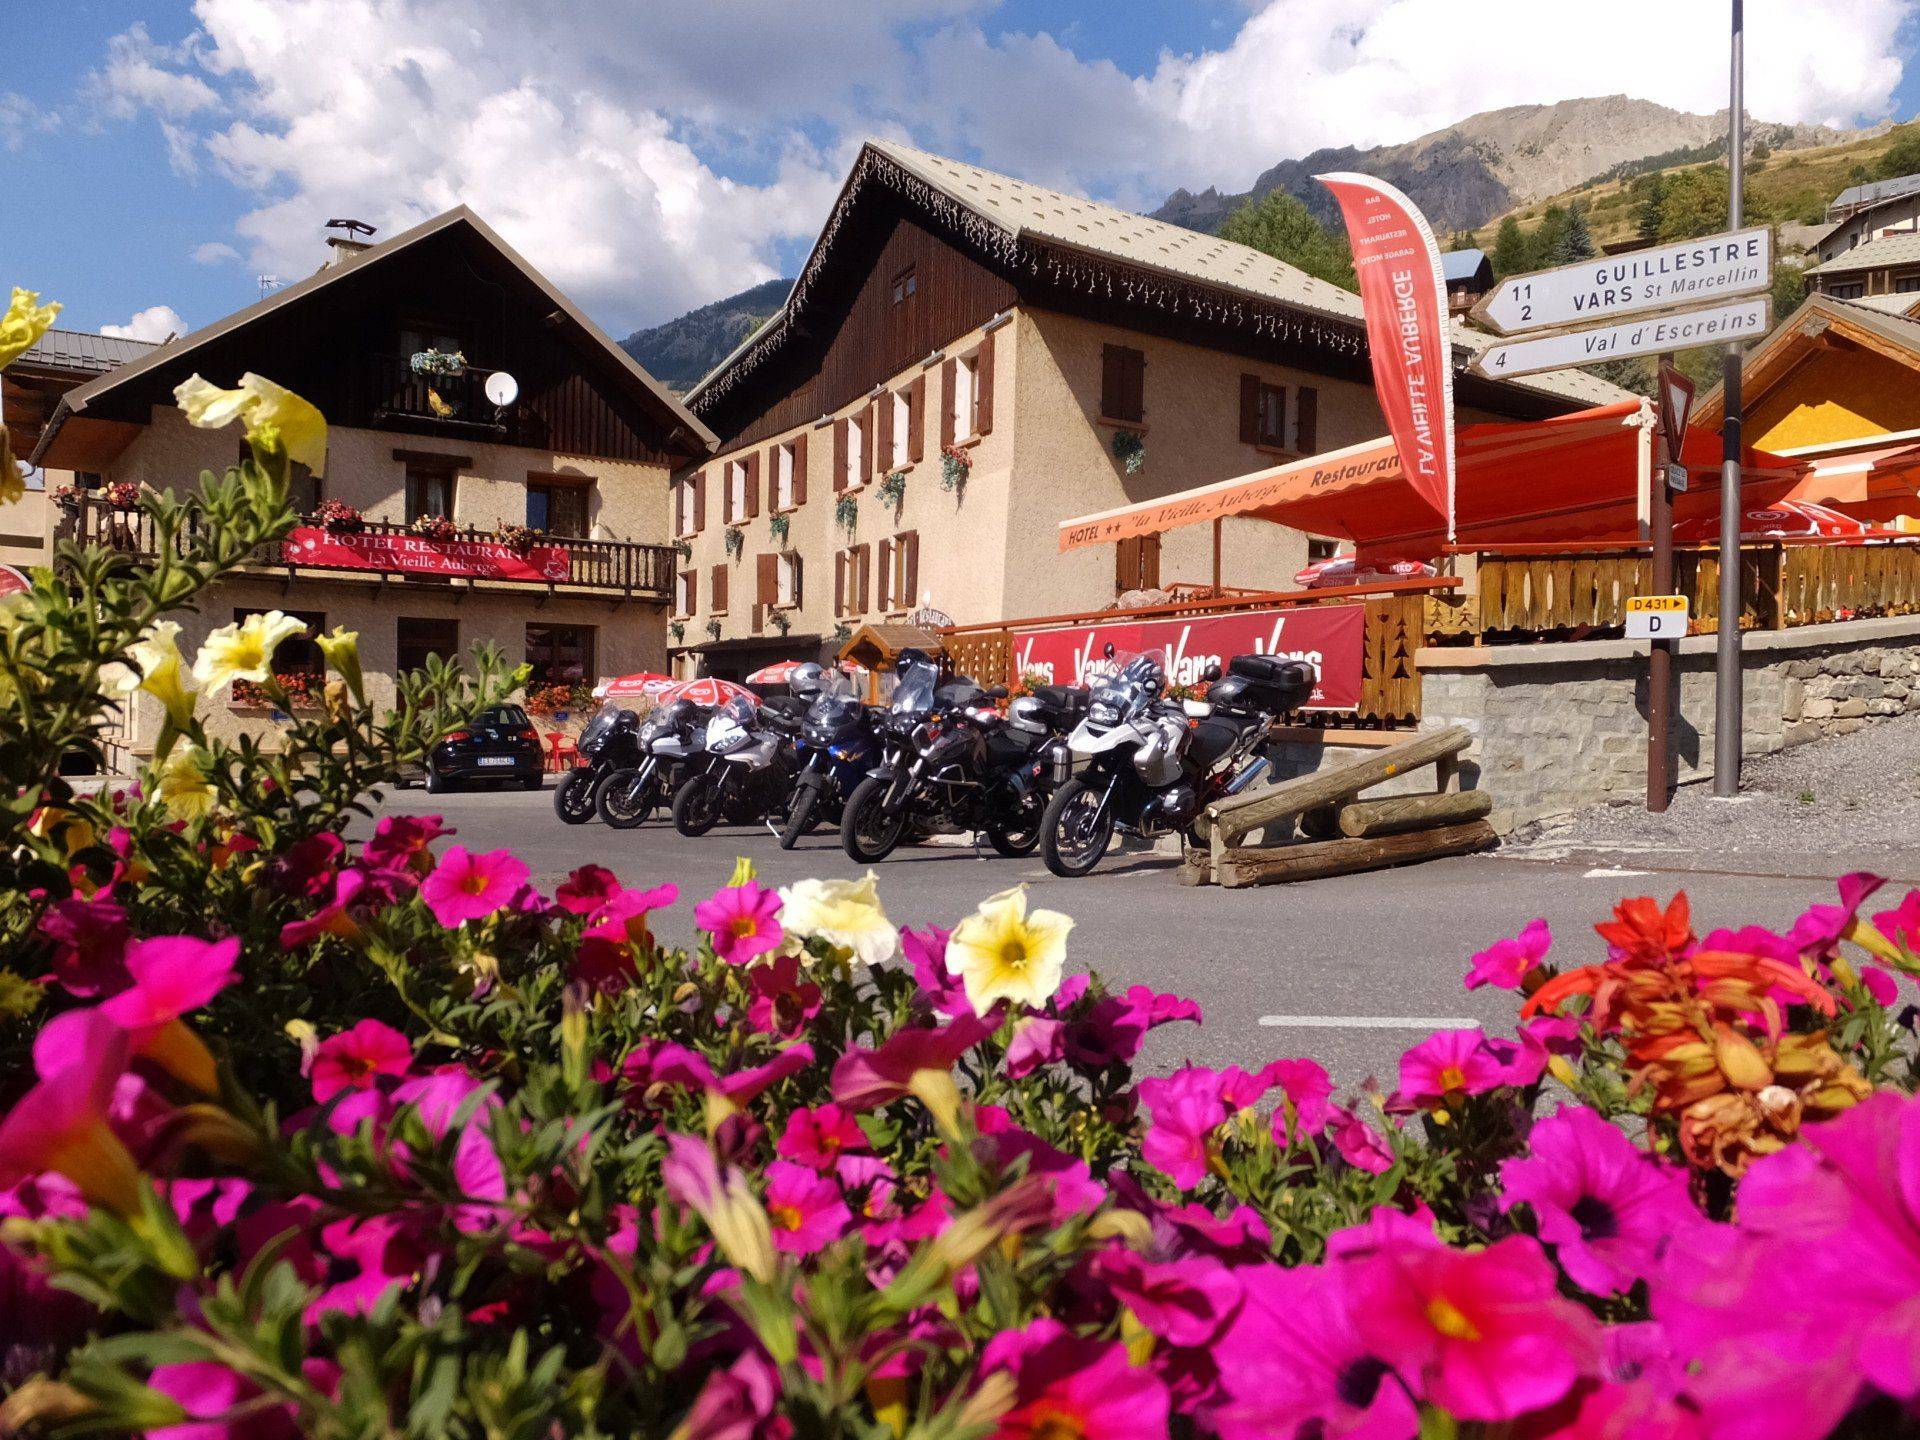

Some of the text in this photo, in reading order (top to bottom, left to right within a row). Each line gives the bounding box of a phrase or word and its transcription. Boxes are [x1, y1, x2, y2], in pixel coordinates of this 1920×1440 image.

[1512, 238, 1760, 301] 11 GUILLESTRE
[1521, 267, 1759, 321] 2 VARS St Marcellin
[1495, 312, 1757, 368] 4 Val d'Escreins
[1068, 526, 1100, 544] HOTEL
[1310, 455, 1400, 487] Restauran
[322, 533, 399, 550] HOTEL
[390, 554, 436, 568] Vieille
[439, 557, 498, 576] Auberge
[1634, 599, 1668, 611] D 431
[1650, 616, 1661, 632] D
